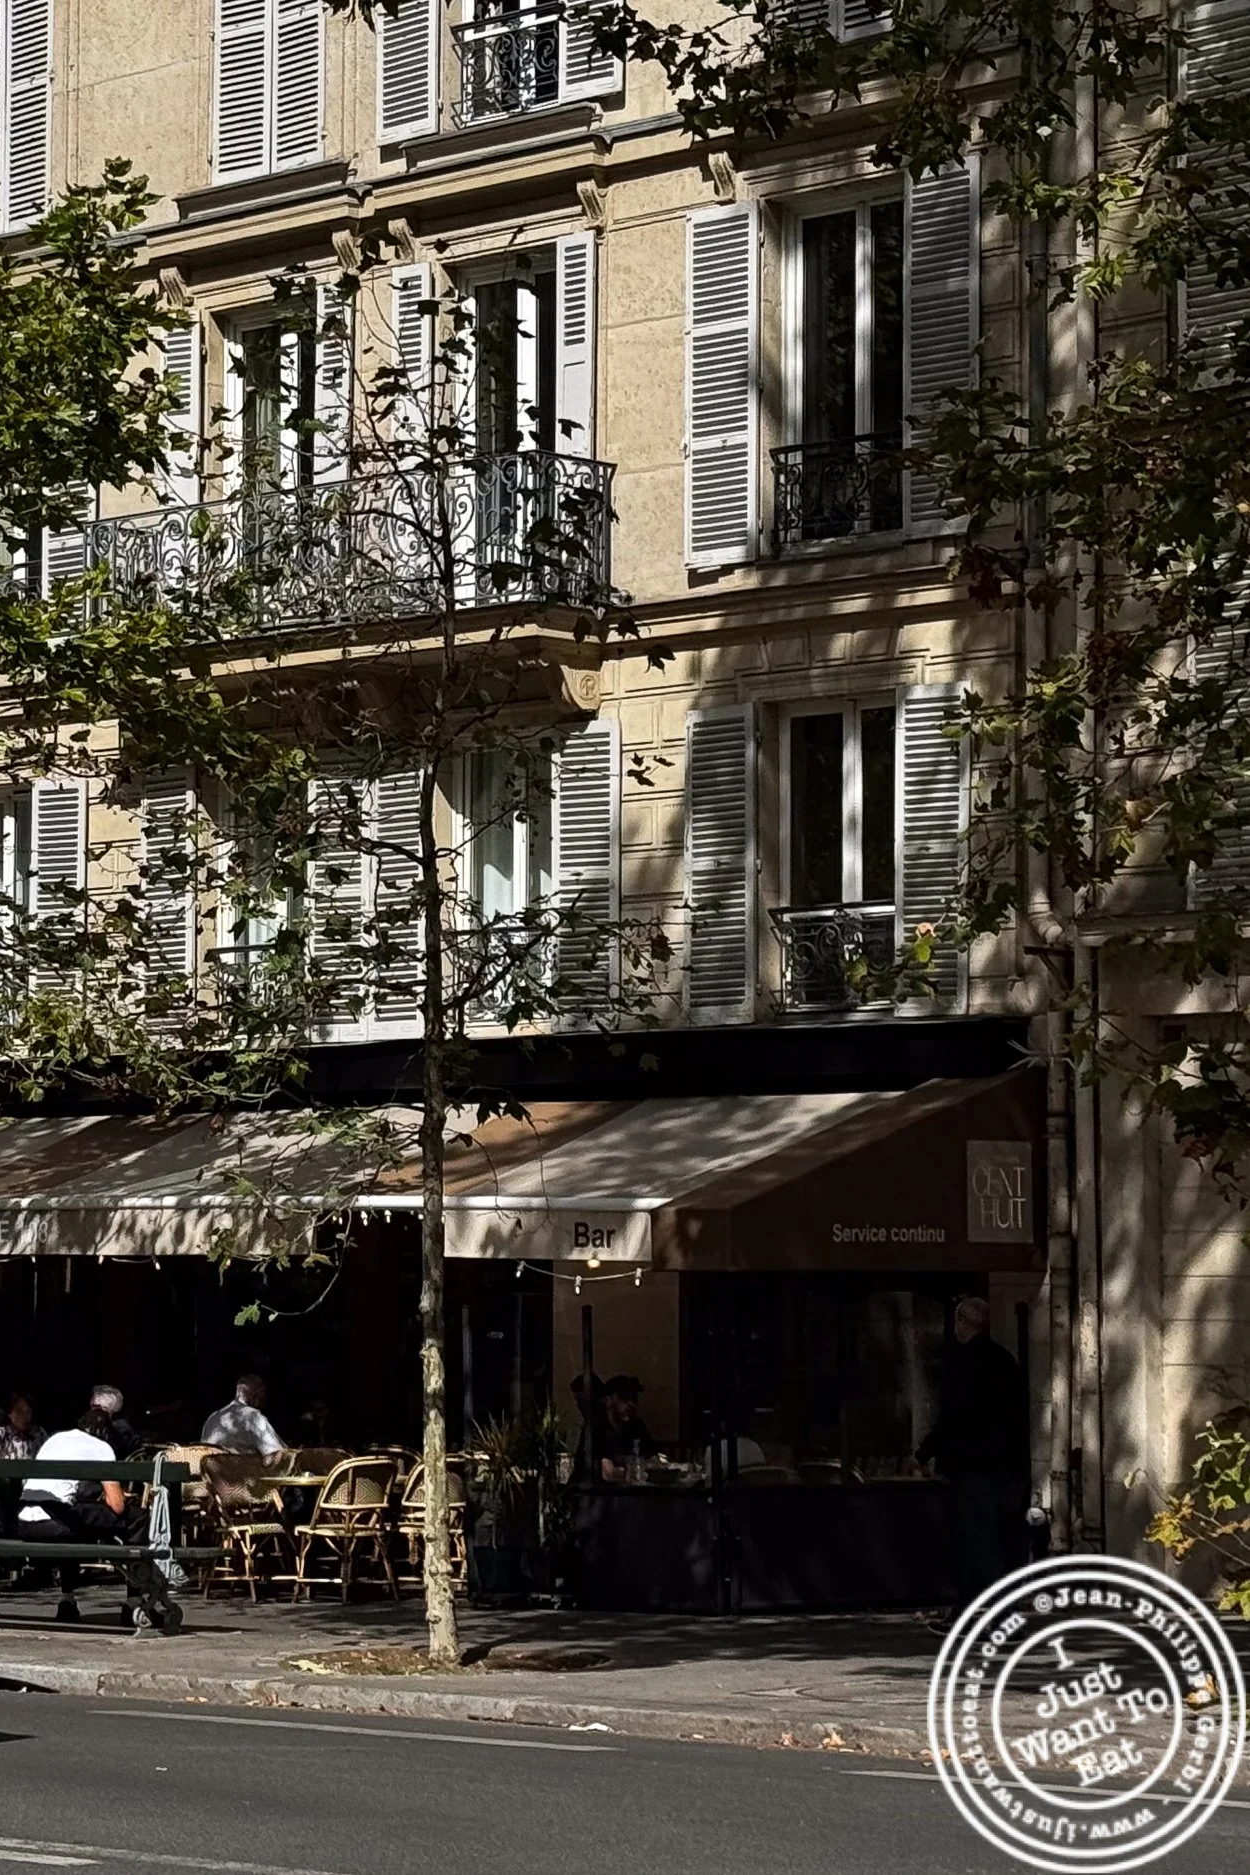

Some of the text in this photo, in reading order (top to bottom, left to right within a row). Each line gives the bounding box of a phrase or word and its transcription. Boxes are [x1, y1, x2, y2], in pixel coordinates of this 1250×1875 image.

[972, 1165, 1027, 1197] CENT
[980, 1197, 1027, 1229] HUIT
[574, 1222, 616, 1249] Bar
[832, 1223, 946, 1243] Service continu
